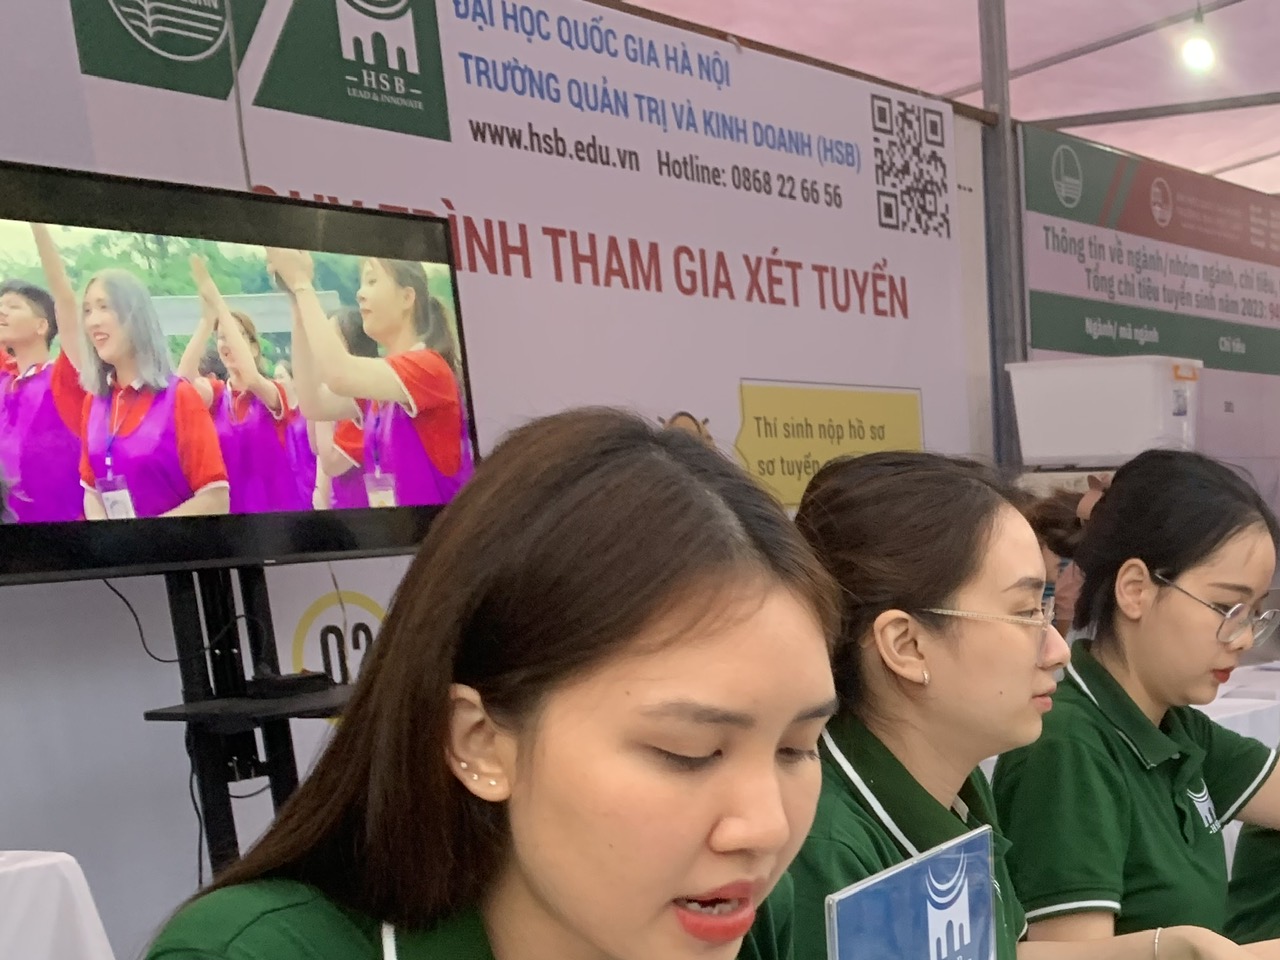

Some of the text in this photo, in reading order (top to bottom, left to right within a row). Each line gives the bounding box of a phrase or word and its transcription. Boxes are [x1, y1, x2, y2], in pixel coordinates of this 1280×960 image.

[502, 0, 551, 43] HỌC
[557, 15, 619, 58] QUỐC
[624, 34, 660, 68] GIA
[664, 42, 694, 76] HÀ
[698, 51, 731, 91] NỘI
[362, 69, 406, 94] HSB
[458, 52, 861, 174] TRƯỜNG QUẢN TRỊ VÀ KINH DOANH (HSB)
[468, 119, 843, 209] www.hsb.edu.vn Hotline: 0868 22 66 56
[1043, 225, 1085, 263] Thông
[1088, 235, 1106, 261] tin
[1109, 233, 1124, 264] về
[541, 226, 663, 293] THAM
[673, 246, 735, 301] GIA
[743, 247, 804, 308] XÉT
[811, 258, 909, 319] TUYỂN
[1085, 262, 1115, 300] Tổng
[1117, 273, 1135, 298] chỉ
[783, 416, 814, 440] sinh
[818, 418, 844, 446] nộp
[849, 417, 866, 440] hồ
[870, 424, 886, 441] sơ
[757, 458, 777, 477] sơ
